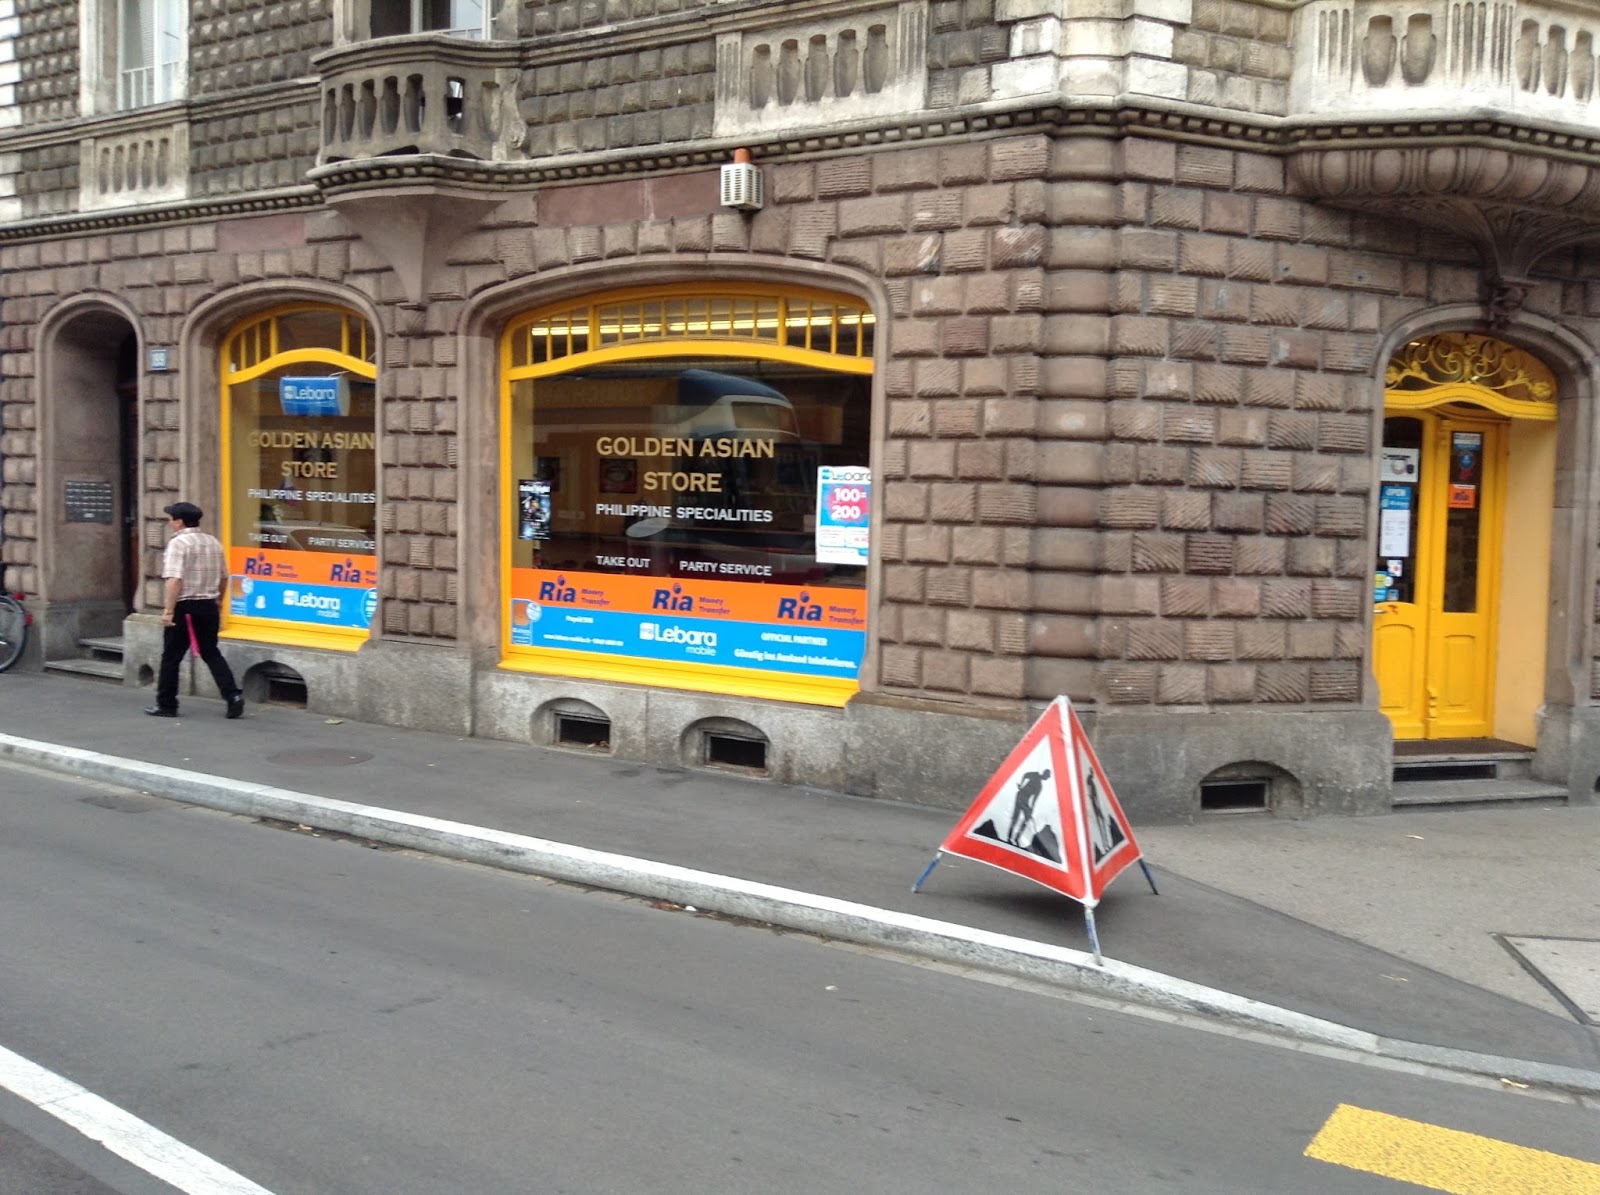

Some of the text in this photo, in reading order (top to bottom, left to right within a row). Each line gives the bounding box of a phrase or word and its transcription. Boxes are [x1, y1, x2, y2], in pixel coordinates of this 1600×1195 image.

[294, 385, 336, 400] Lebara
[249, 432, 375, 450] GOLDEN ASIAN
[596, 436, 775, 459] GOLDEN ASIAN
[281, 461, 338, 478] STORE
[643, 471, 723, 493] STORE
[248, 488, 375, 504] PHILIPPINE SPECIALITIES
[595, 503, 774, 522] PHILIPPINE SPECIALITIES
[831, 505, 861, 520] 200
[249, 533, 288, 544] TAKE OUT
[308, 537, 375, 550] PARTY SERVICE
[244, 553, 273, 577] Ria
[595, 555, 651, 568] TAKE OUT
[679, 560, 773, 577] PARTY SERVICE
[330, 559, 361, 583] Ria
[539, 575, 576, 603] Ria
[652, 583, 693, 612] Ria
[294, 590, 340, 610] Lebara
[699, 596, 724, 605] Money
[777, 591, 823, 622] Ria
[828, 605, 857, 615] Money
[828, 616, 865, 625] Transfer
[655, 623, 717, 647] Lebara
[685, 647, 716, 656] mobile
